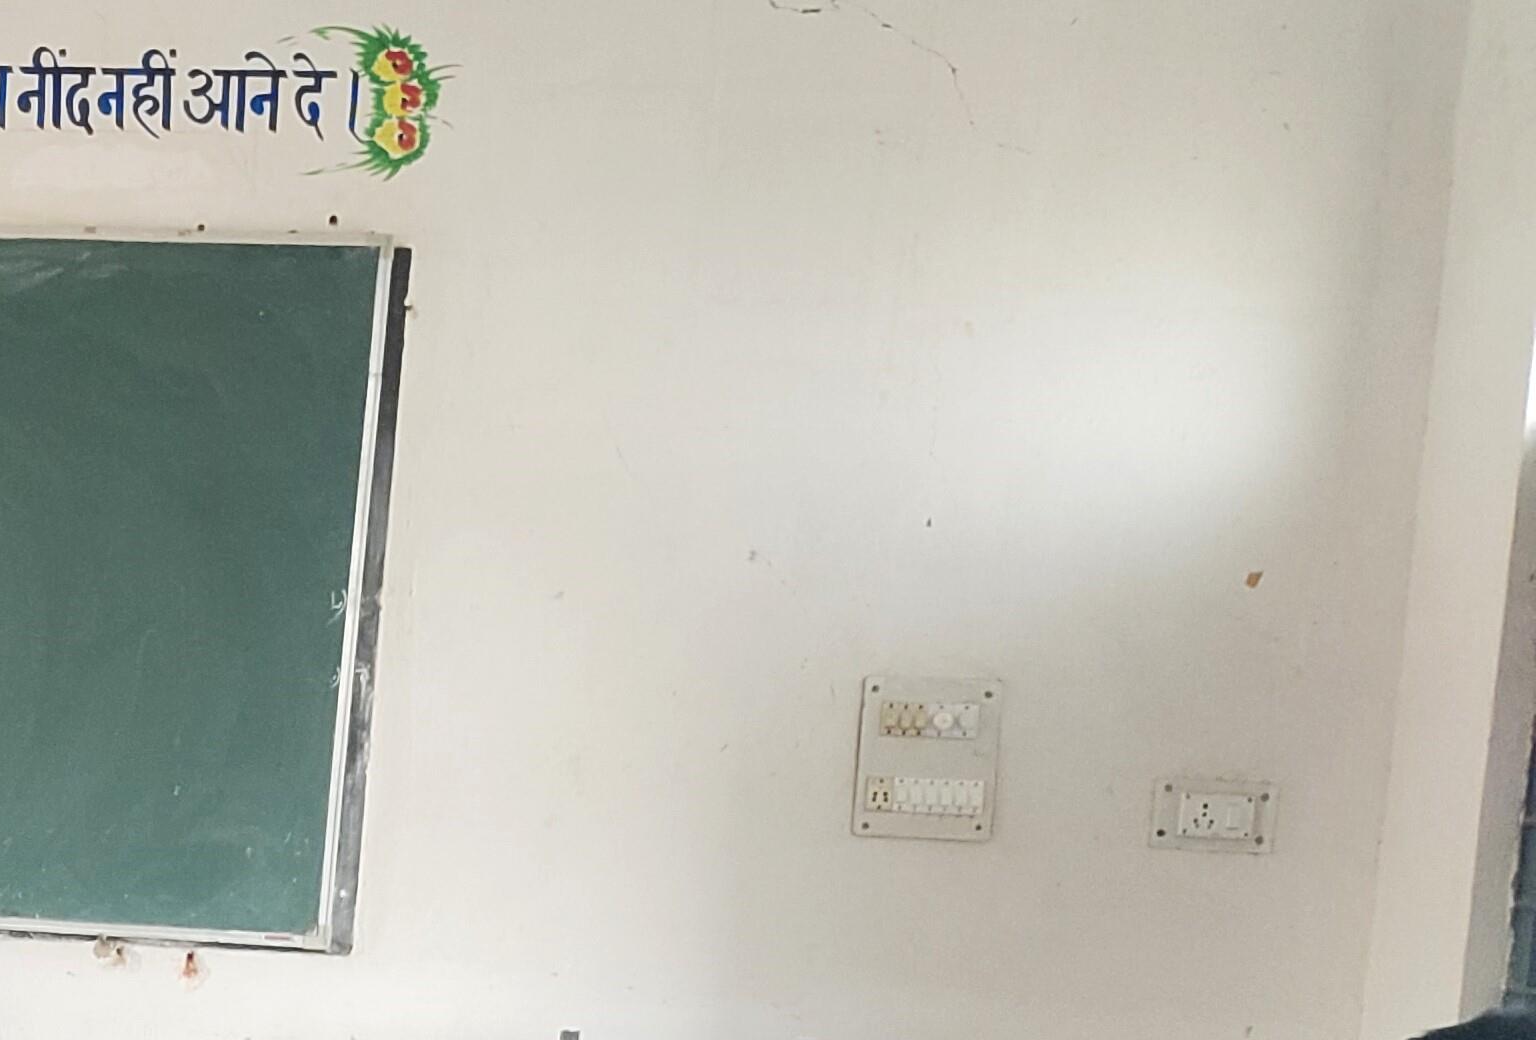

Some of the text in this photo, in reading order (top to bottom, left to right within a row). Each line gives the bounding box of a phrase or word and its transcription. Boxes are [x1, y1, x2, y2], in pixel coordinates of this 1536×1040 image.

[16, 46, 97, 136] नींद
[97, 48, 178, 140] नहीं
[183, 51, 288, 134] आने
[292, 52, 339, 141] दे
